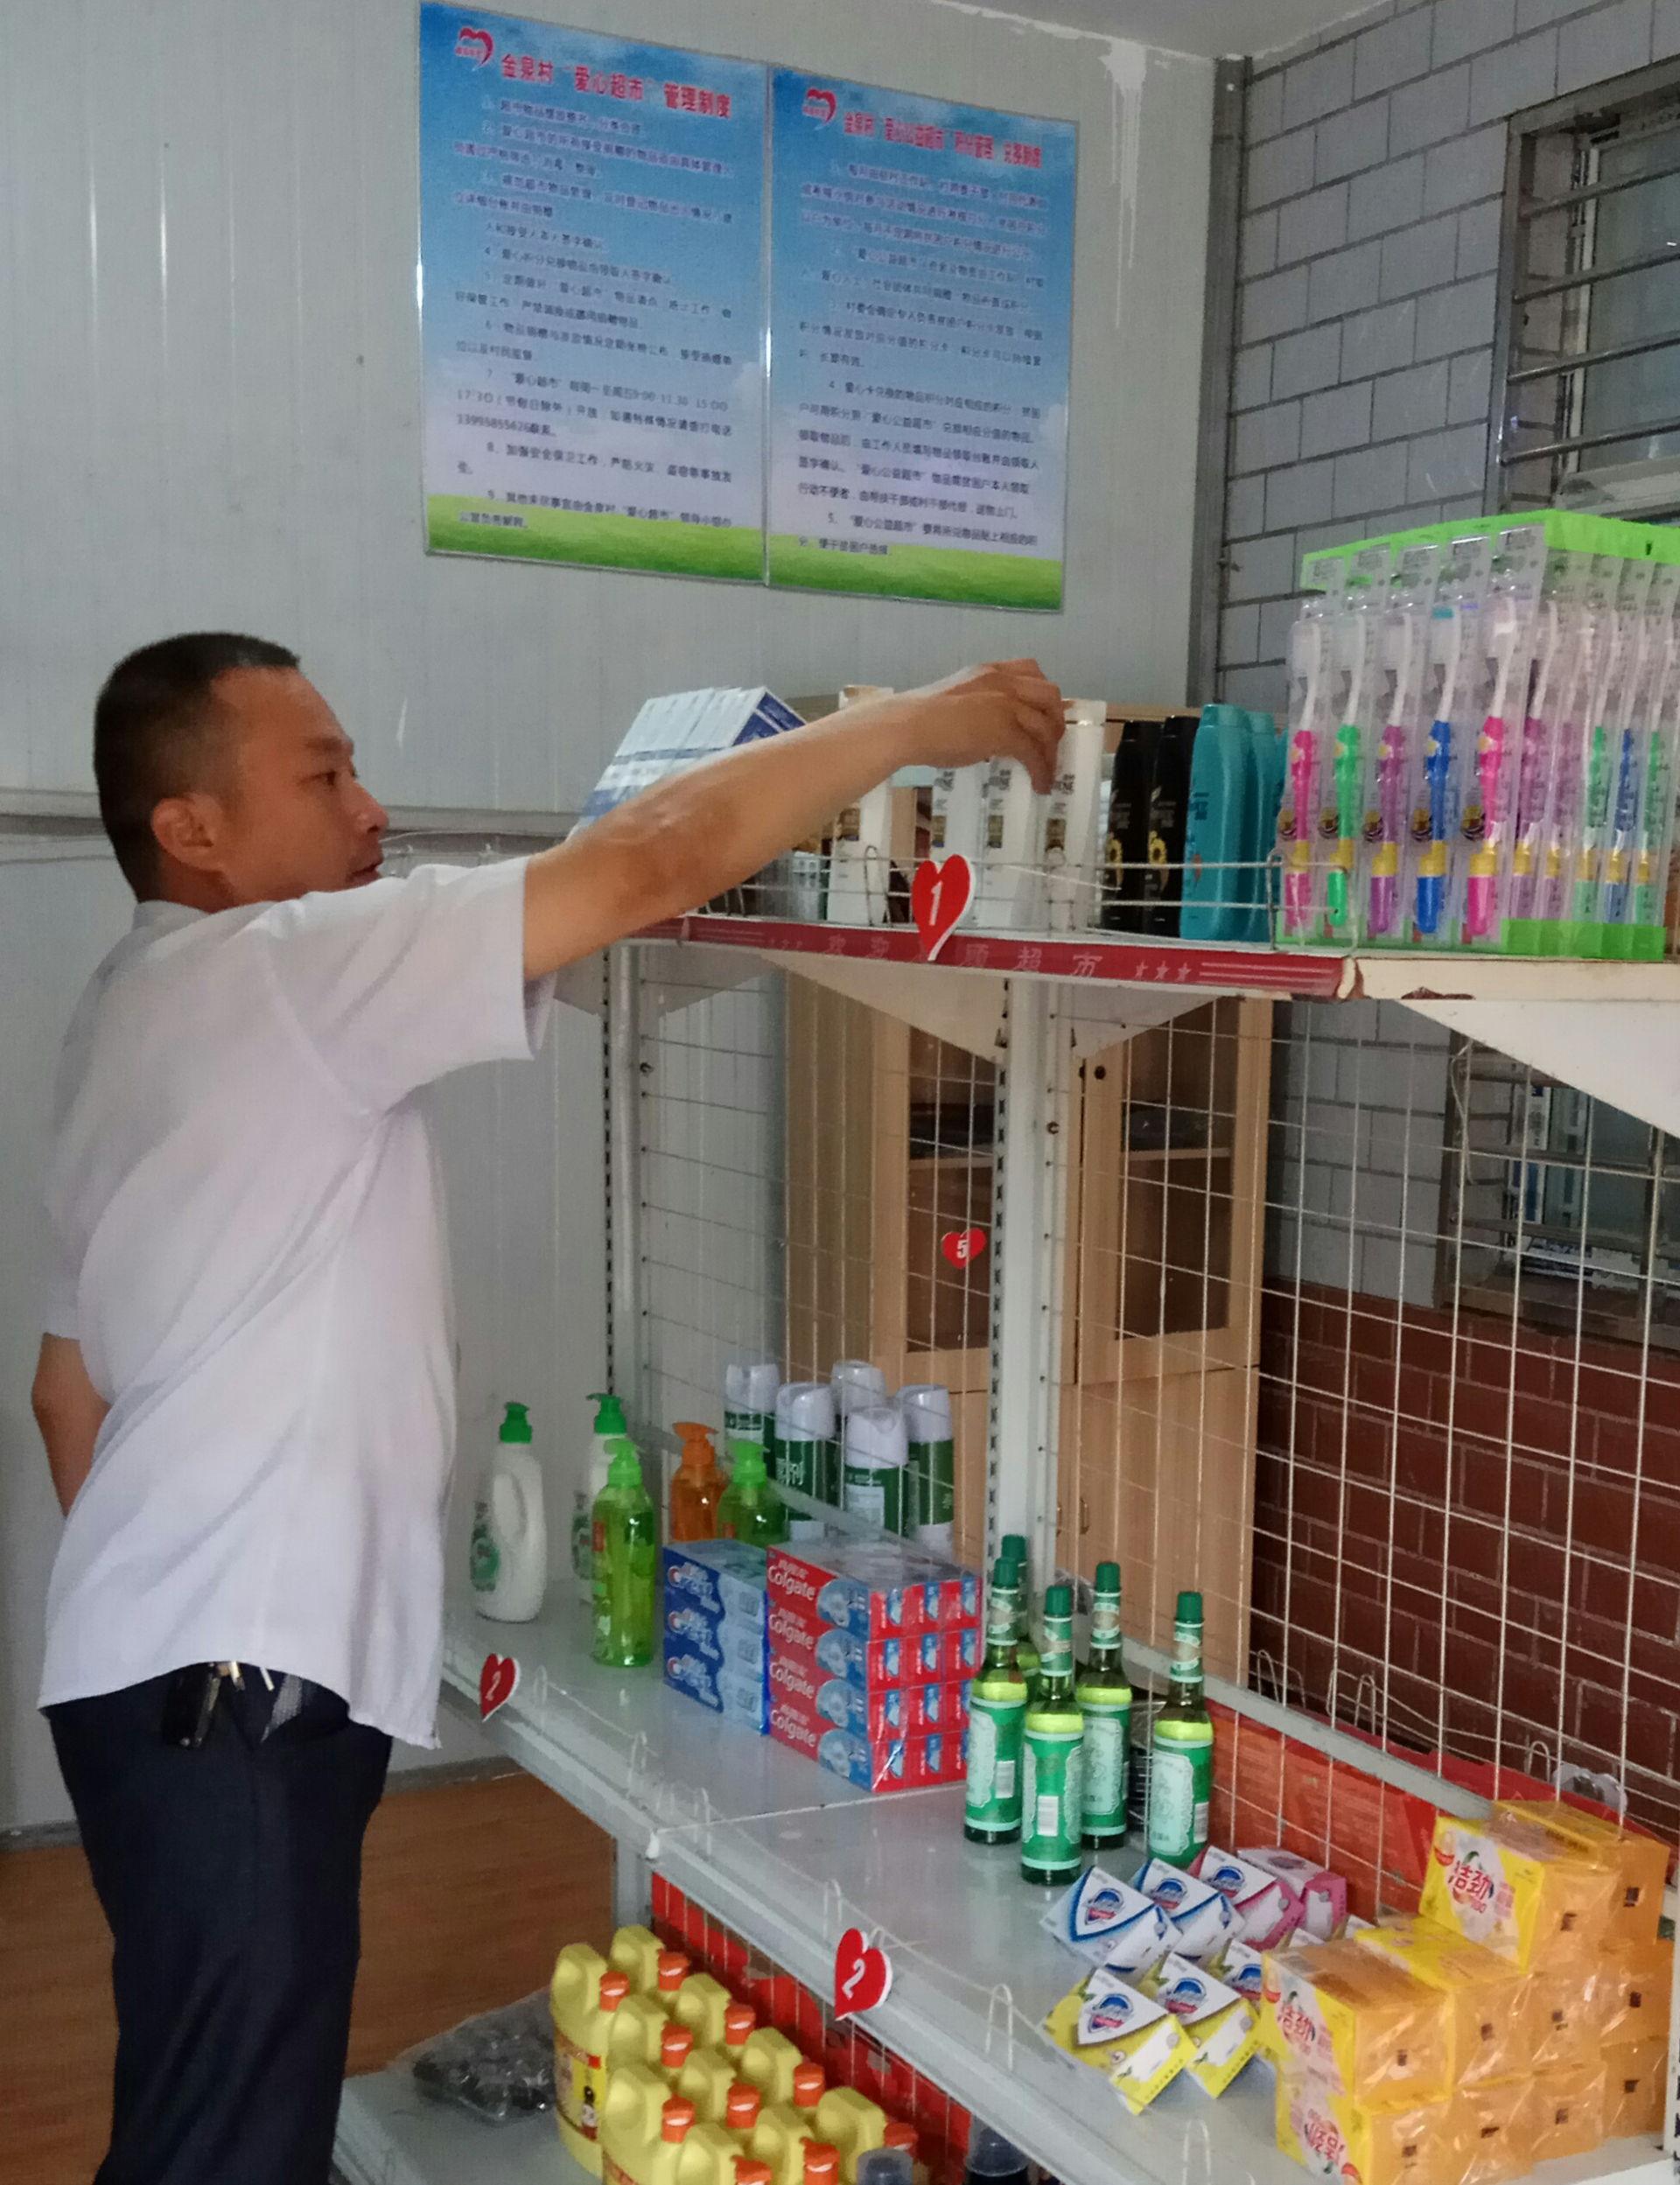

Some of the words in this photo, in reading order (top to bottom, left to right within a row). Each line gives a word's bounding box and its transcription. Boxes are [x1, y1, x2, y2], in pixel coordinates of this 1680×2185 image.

[663, 82, 732, 119] 管理制度
[928, 880, 943, 926] 1
[956, 1239, 969, 1258] 5
[767, 1565, 816, 1601] Colgate
[768, 1613, 815, 1649] Colgate
[769, 1661, 816, 1699] Colgate
[770, 1709, 816, 1748] Colgate
[841, 1958, 866, 1999] 2
